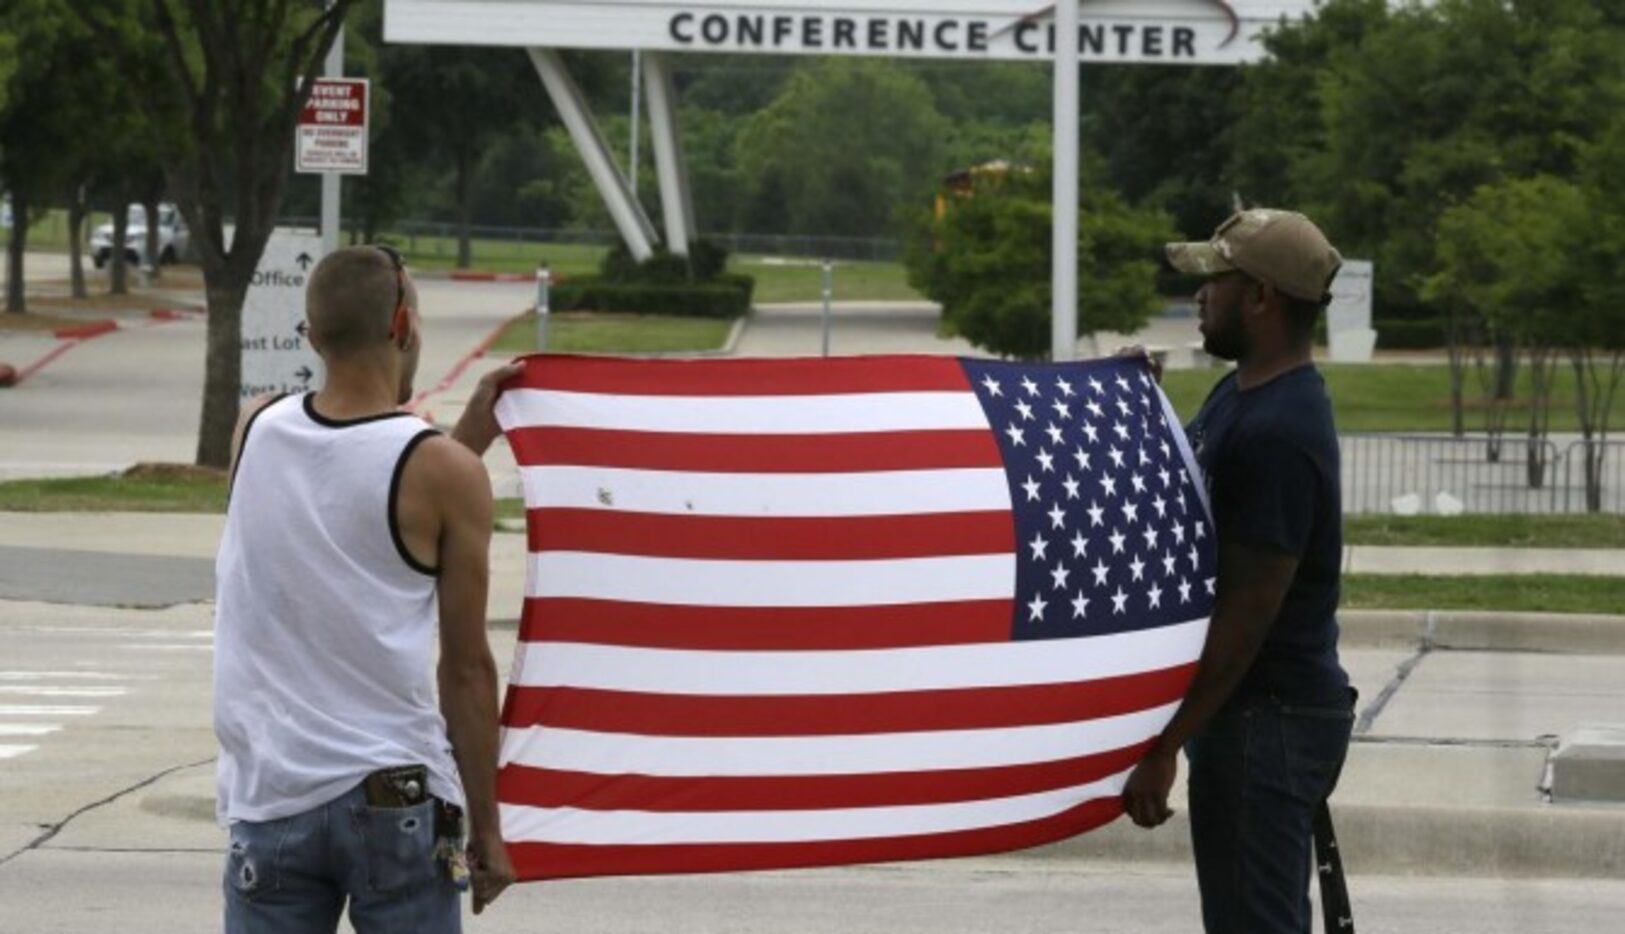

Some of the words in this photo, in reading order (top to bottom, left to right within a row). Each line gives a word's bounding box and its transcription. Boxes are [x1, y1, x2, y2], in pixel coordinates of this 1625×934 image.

[669, 12, 989, 51] CONFERENCE
[315, 111, 348, 122] ONLY
[241, 337, 265, 350] ast
[273, 335, 300, 350] Lot
